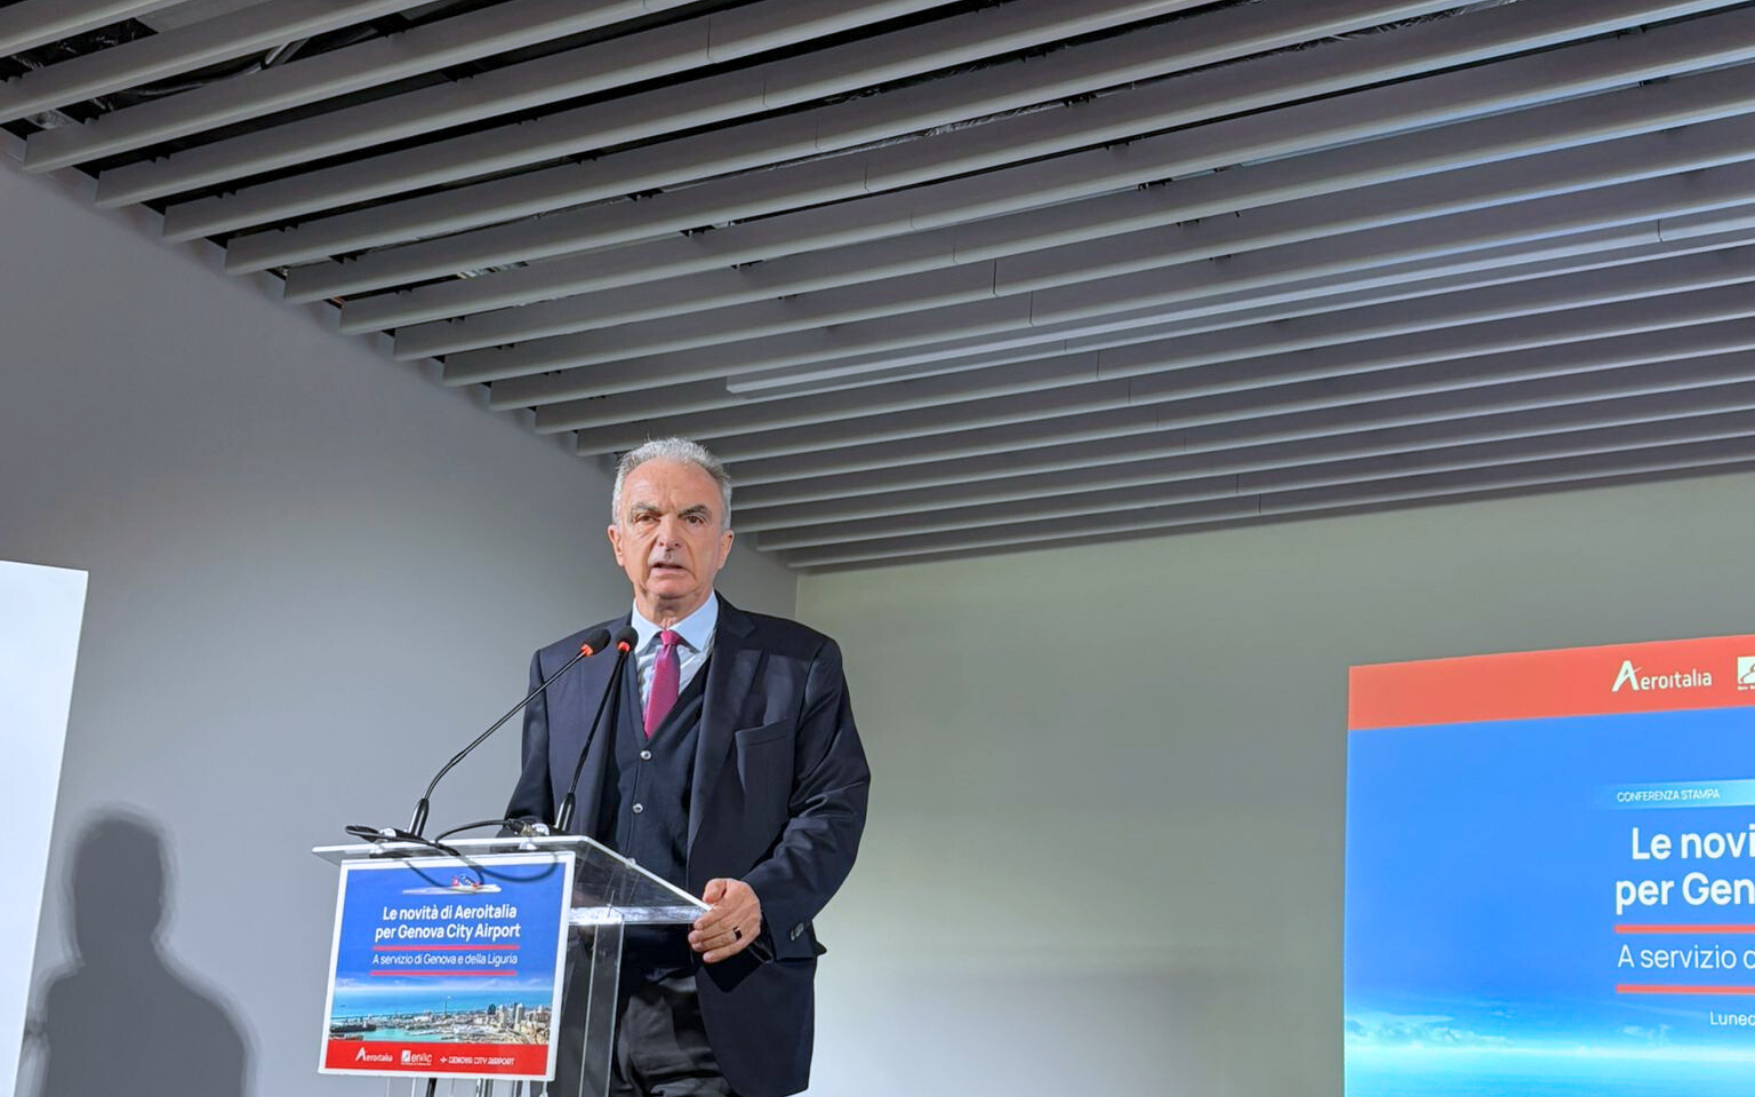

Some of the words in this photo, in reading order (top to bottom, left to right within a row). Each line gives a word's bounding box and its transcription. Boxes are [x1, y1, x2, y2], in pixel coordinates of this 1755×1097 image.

[1611, 660, 1712, 692] Aeroitalia
[1617, 791, 1680, 802] CONFERENZA
[1681, 788, 1720, 800] STAMPA
[1632, 827, 1672, 860] Le
[1616, 880, 1674, 915] per
[1682, 872, 1755, 906] Gen
[383, 906, 397, 920] Le
[399, 904, 438, 920] novità
[440, 905, 453, 919] di
[375, 926, 396, 943] per
[398, 924, 444, 939] Genova
[446, 923, 474, 942] City
[475, 923, 521, 942] Airport
[372, 954, 379, 964] A
[380, 954, 413, 965] servizio
[414, 953, 423, 965] di
[423, 953, 457, 965] Genova
[457, 956, 464, 965] e
[464, 953, 486, 965] della
[487, 953, 518, 967] Liguria
[1617, 944, 1635, 968] A
[1640, 944, 1737, 969] servizio
